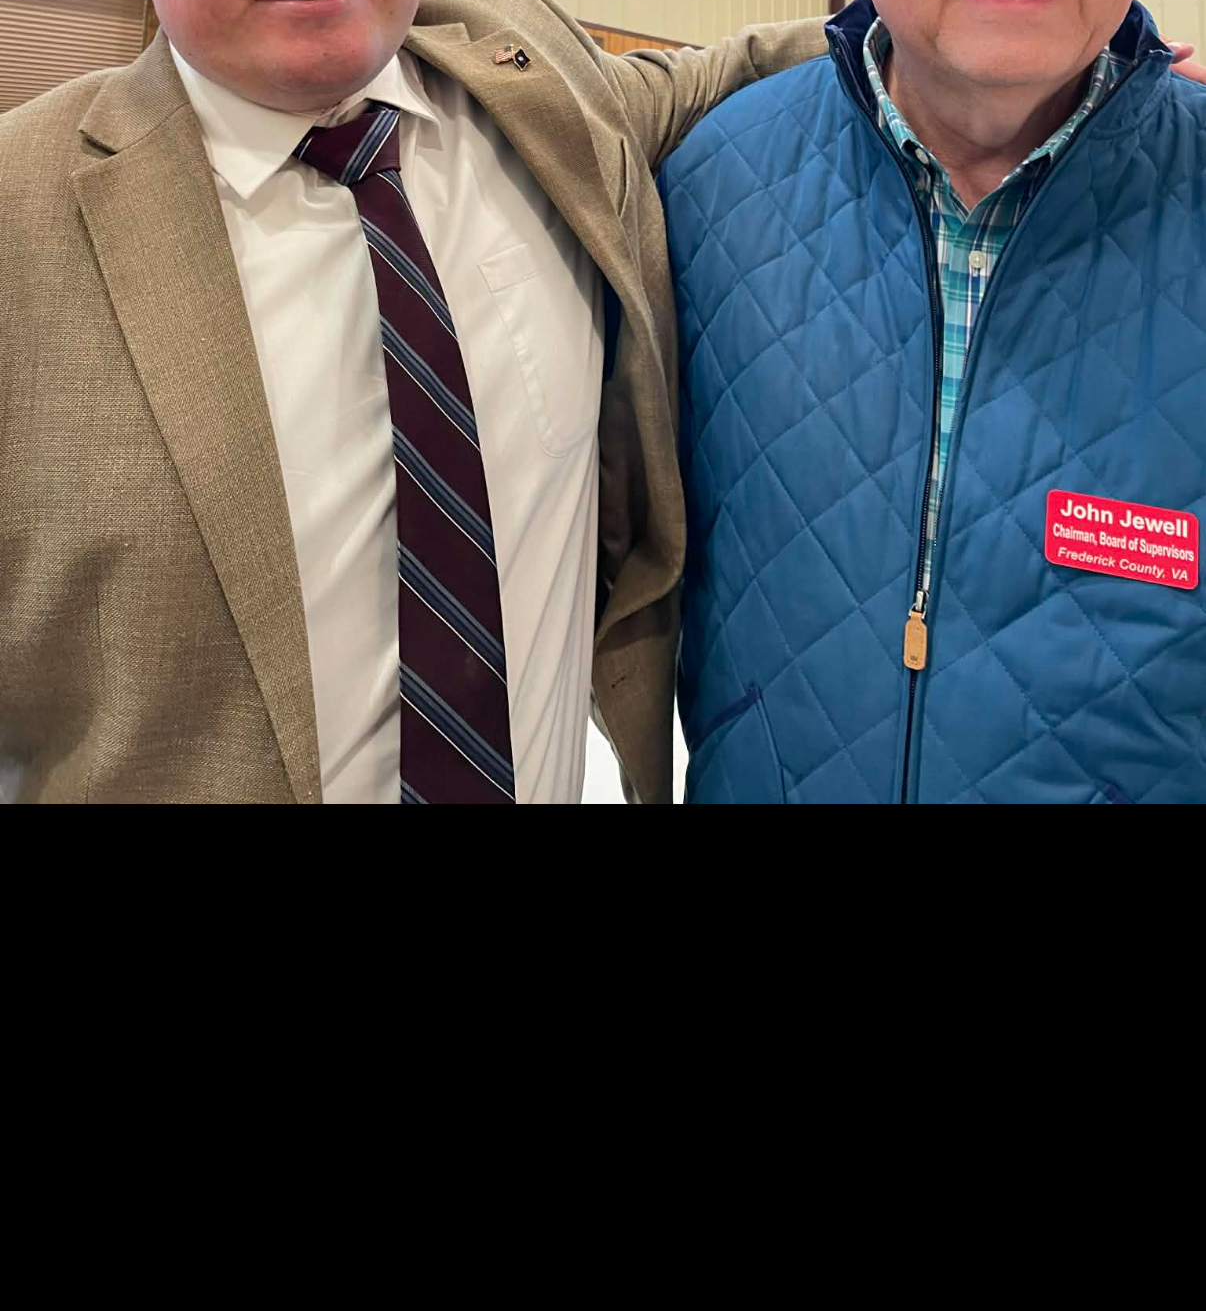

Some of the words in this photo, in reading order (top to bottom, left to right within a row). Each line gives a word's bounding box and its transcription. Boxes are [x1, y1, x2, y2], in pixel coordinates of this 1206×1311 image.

[1060, 499, 1113, 524] John
[1119, 510, 1188, 538] Jewell
[1053, 523, 1097, 546] Chairman,
[1099, 532, 1127, 549] Board
[1128, 538, 1139, 551] of
[1139, 539, 1194, 562] Supervisors
[1057, 547, 1116, 568] Frederick
[1171, 568, 1188, 581] VA
